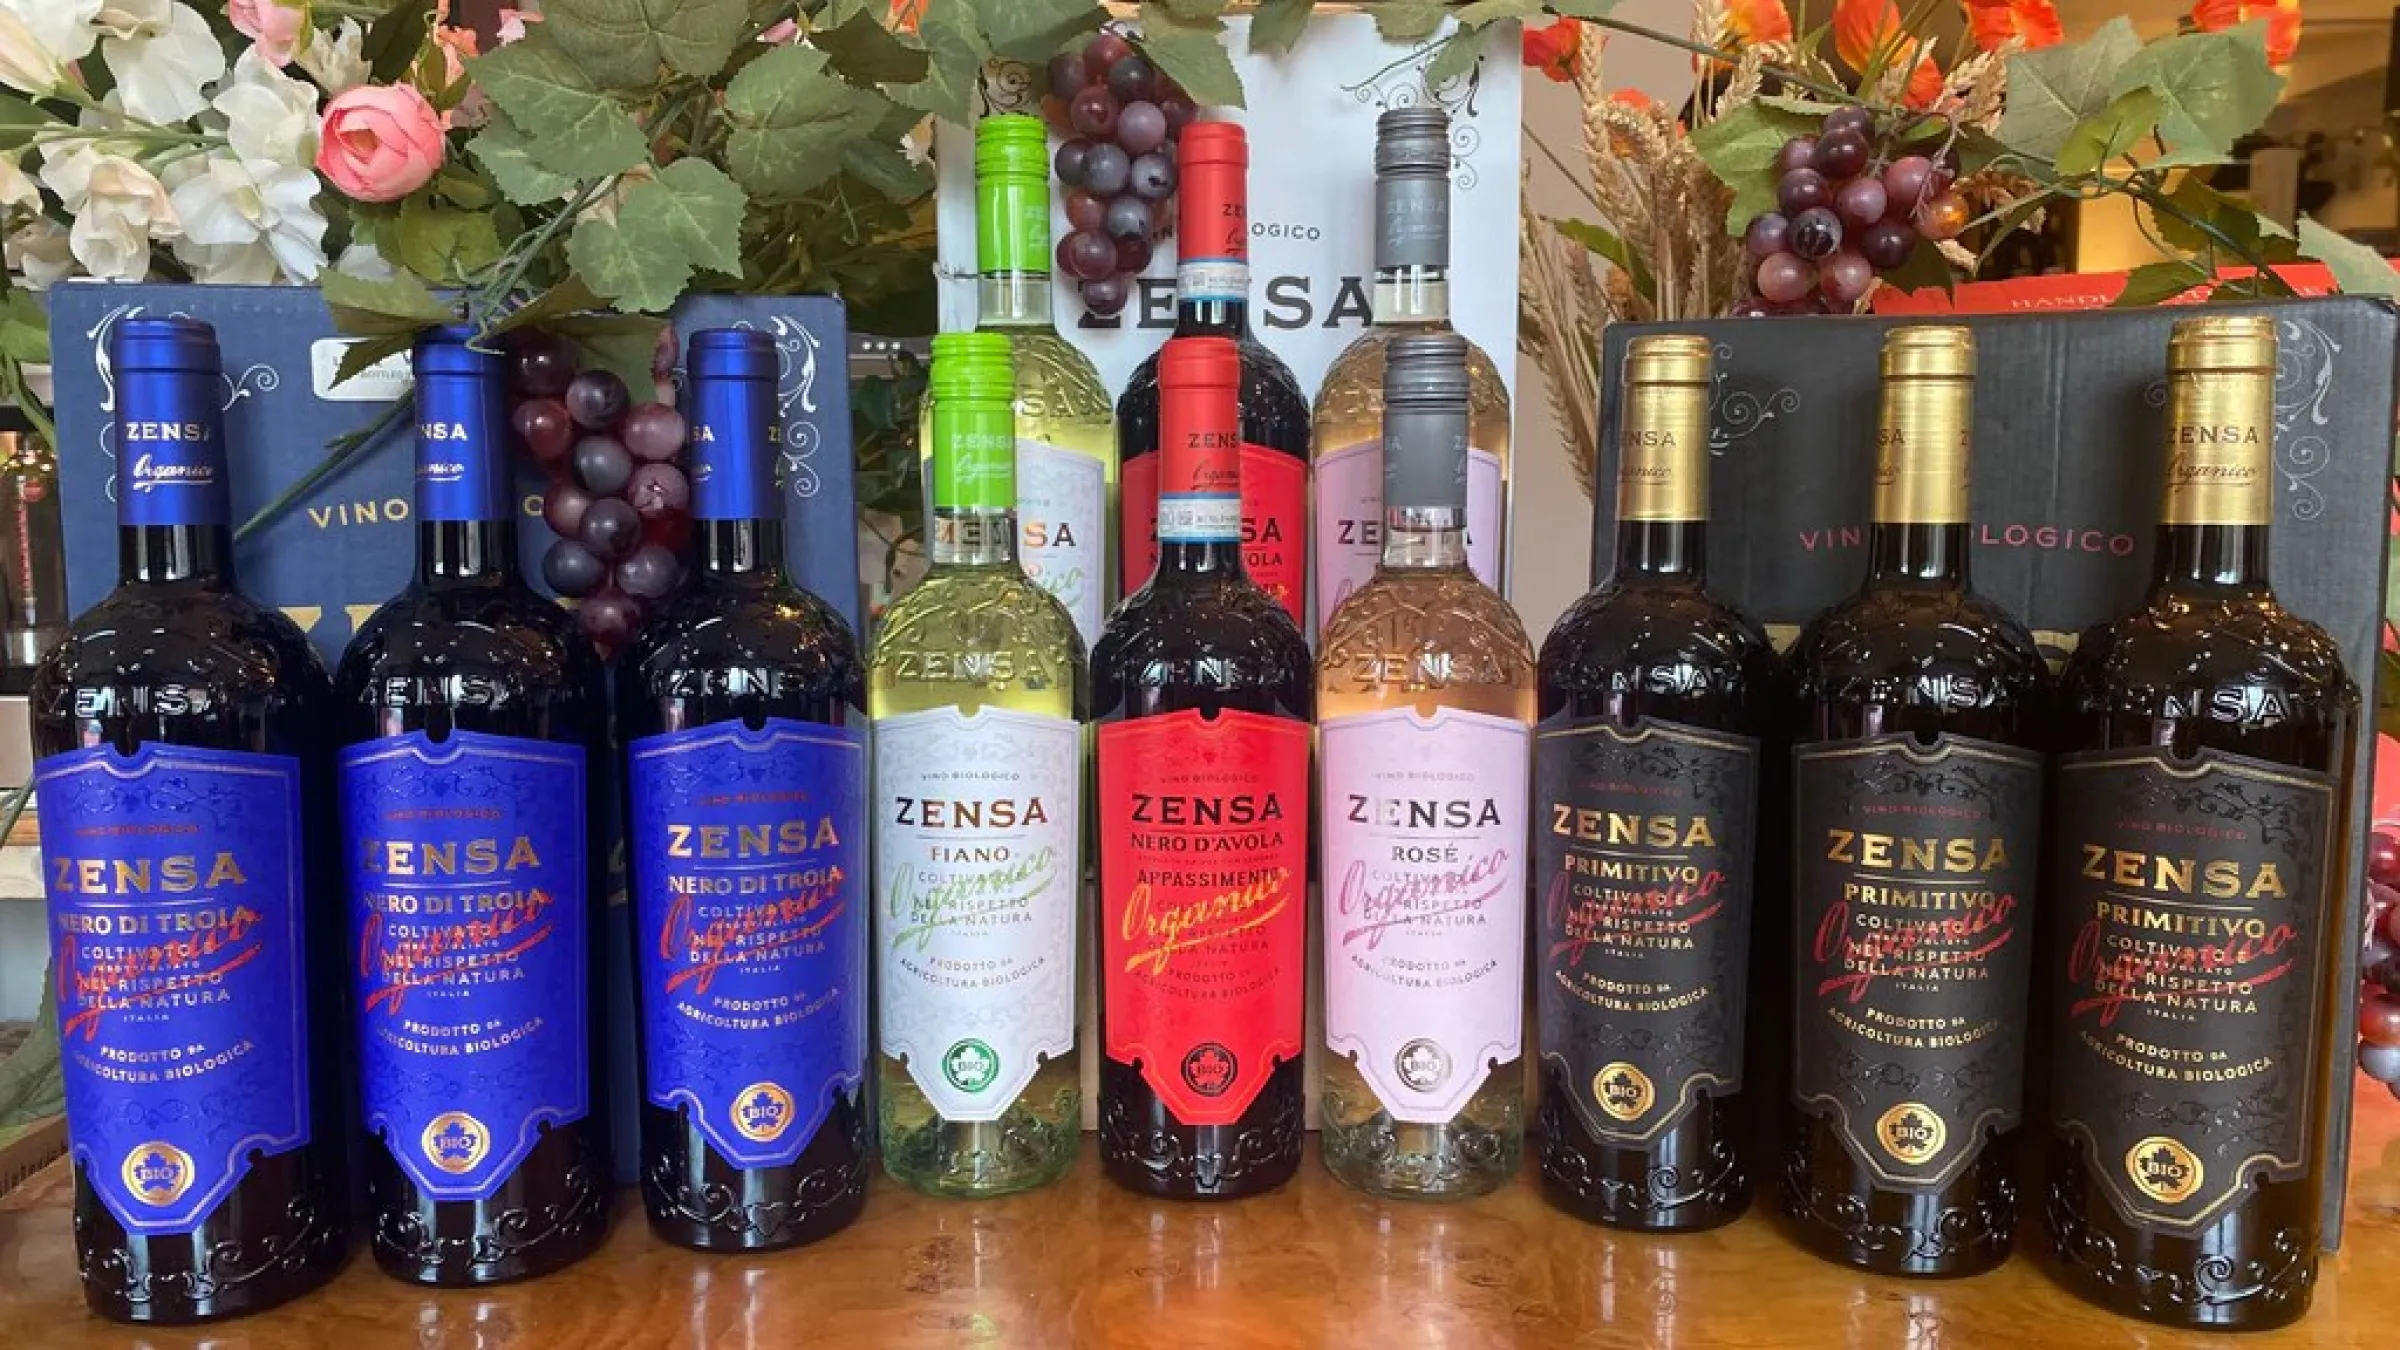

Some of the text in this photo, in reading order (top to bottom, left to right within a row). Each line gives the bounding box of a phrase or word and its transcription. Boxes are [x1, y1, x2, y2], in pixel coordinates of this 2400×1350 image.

[308, 498, 409, 529] VINO
[1800, 527, 1861, 552] VIN
[1981, 524, 2134, 556] LOGICO
[895, 796, 1049, 829] ZENSA
[1131, 791, 1283, 826] ZENSA
[1347, 793, 1502, 829] ZENSA
[667, 815, 841, 858] ZENSA
[1553, 803, 1717, 848] ZENSA
[931, 845, 1010, 863] FIANO
[1131, 831, 1284, 852] NERO D'AVOLA
[1391, 842, 1459, 864] ROSÉ
[1827, 828, 2010, 873] ZENSA
[361, 836, 542, 875] ZENSA
[54, 852, 249, 894] ZENSA
[1564, 853, 1699, 886] PRIMITIVO
[2082, 843, 2289, 899] ZENSA
[667, 874, 733, 895] NERO
[739, 875, 768, 895] DI
[1844, 882, 1996, 910] PRIMITIVO
[425, 896, 454, 914] DI
[57, 912, 112, 935] NERO
[118, 915, 149, 934] DI
[2096, 901, 2266, 939] PRIMITIVO
[1621, 934, 1695, 950] NATURA
[442, 967, 526, 986] NATURA
[929, 956, 997, 972] PRODOTTO
[1914, 966, 1989, 981] NATURA
[1582, 972, 1652, 995] PRODOTTO
[2146, 971, 2253, 996] RISPETTO
[140, 988, 231, 1009] NATURA
[713, 995, 789, 1011] PRODOTTO
[1636, 986, 1710, 1012] BIOLOGICA
[2167, 993, 2259, 1015] NATURA
[402, 1018, 480, 1038] PRODOTTO
[1865, 1007, 1946, 1030] PRODOTTO
[465, 1016, 544, 1054] BIOLOGICA
[2115, 1032, 2204, 1063] PRODOTTO
[100, 1044, 182, 1063] PRODOTTO
[165, 1040, 256, 1080] BIOLOGICA
[2184, 1055, 2274, 1083] BIOLOGICA
[749, 1104, 779, 1120] BIO
[1895, 1125, 1929, 1140] BIO
[2146, 1163, 2183, 1179] BIO
